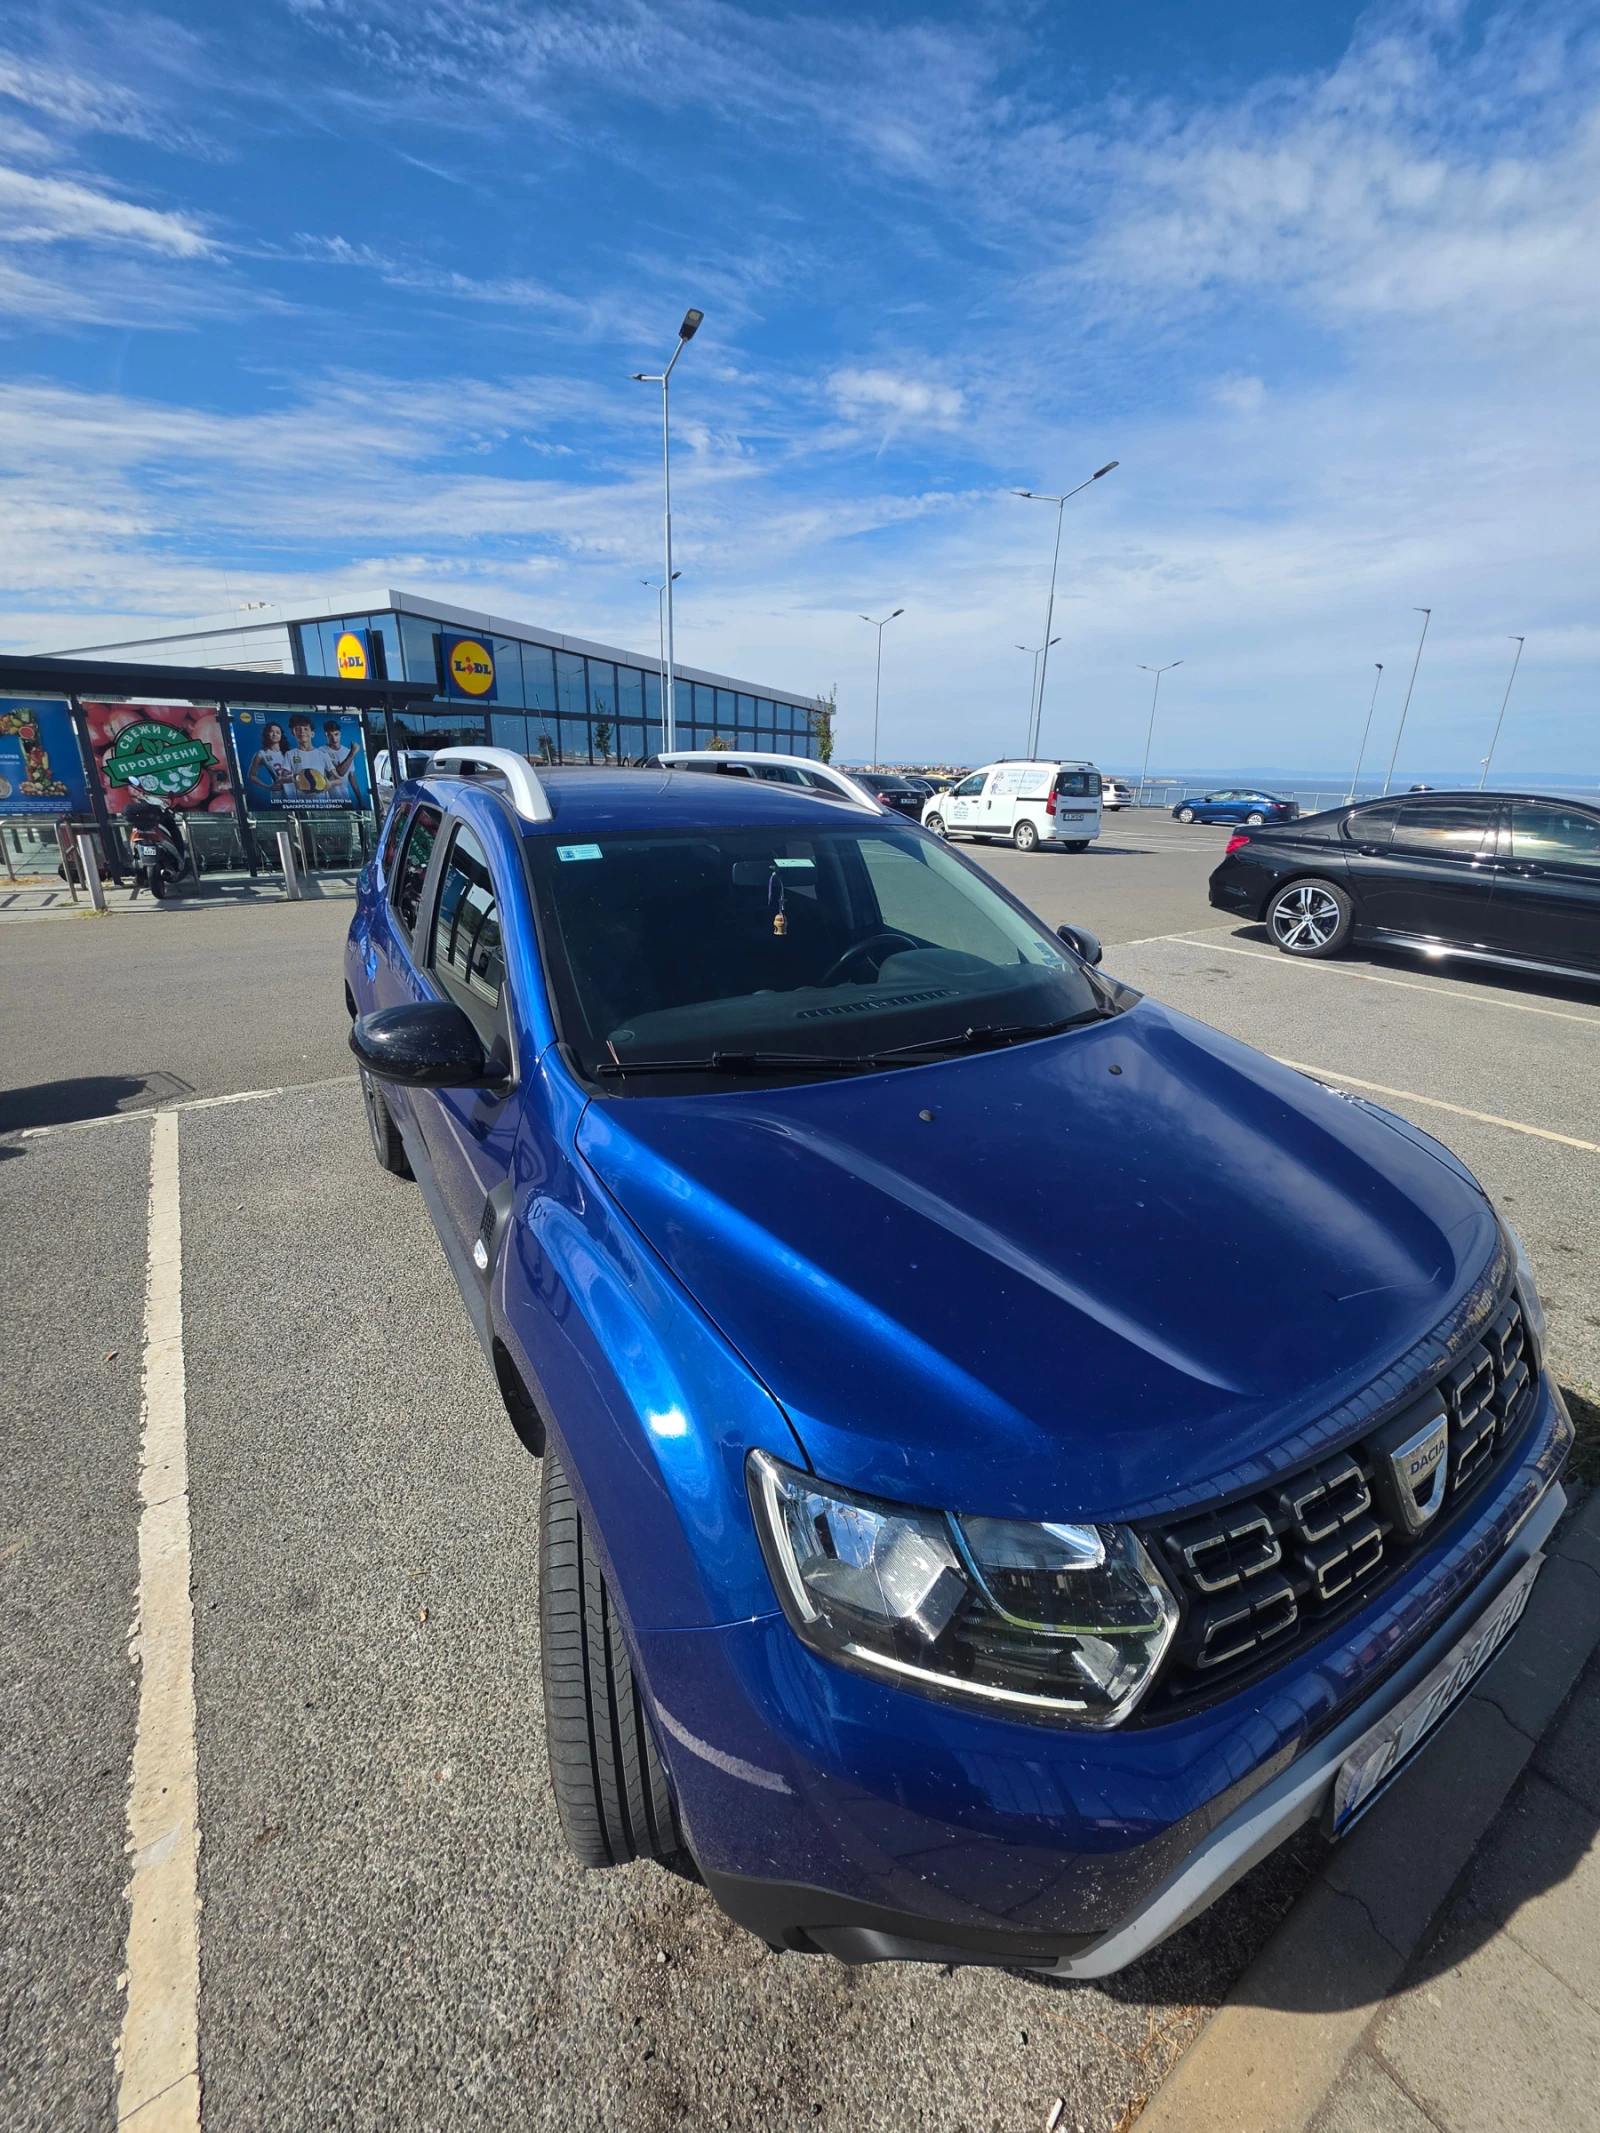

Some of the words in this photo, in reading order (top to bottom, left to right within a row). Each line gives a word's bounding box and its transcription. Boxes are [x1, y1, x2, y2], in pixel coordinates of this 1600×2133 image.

[120, 725, 161, 749] СВЕЖИ
[167, 730, 178, 740] И
[118, 747, 199, 772] ПРОВЕРЕНИ
[1410, 1439, 1445, 1476] DACIA
